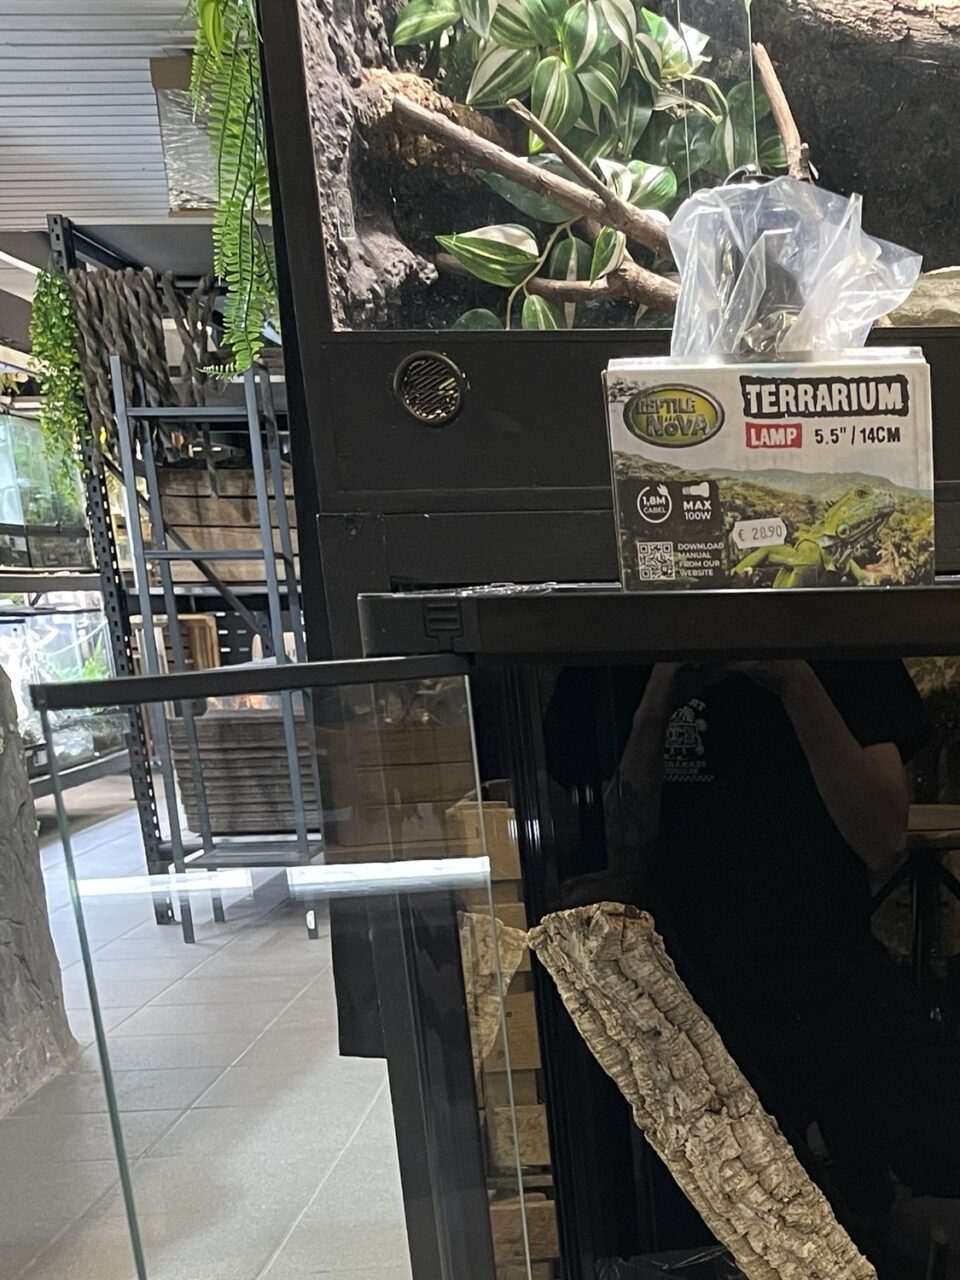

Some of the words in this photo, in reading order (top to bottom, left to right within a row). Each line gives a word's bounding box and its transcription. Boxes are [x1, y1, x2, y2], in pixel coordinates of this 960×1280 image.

[745, 381, 905, 414] TERRARIUM
[637, 396, 696, 415] REPTILE
[750, 428, 798, 446] LAMP
[815, 427, 847, 445] 5.5"
[860, 426, 901, 444] 14CM
[683, 500, 712, 511] MAX
[684, 511, 712, 520] 100W
[738, 529, 745, 541] €
[752, 525, 783, 541] 28.90
[678, 542, 724, 550] DOWNLOAD
[680, 569, 714, 577] WEBSITE
